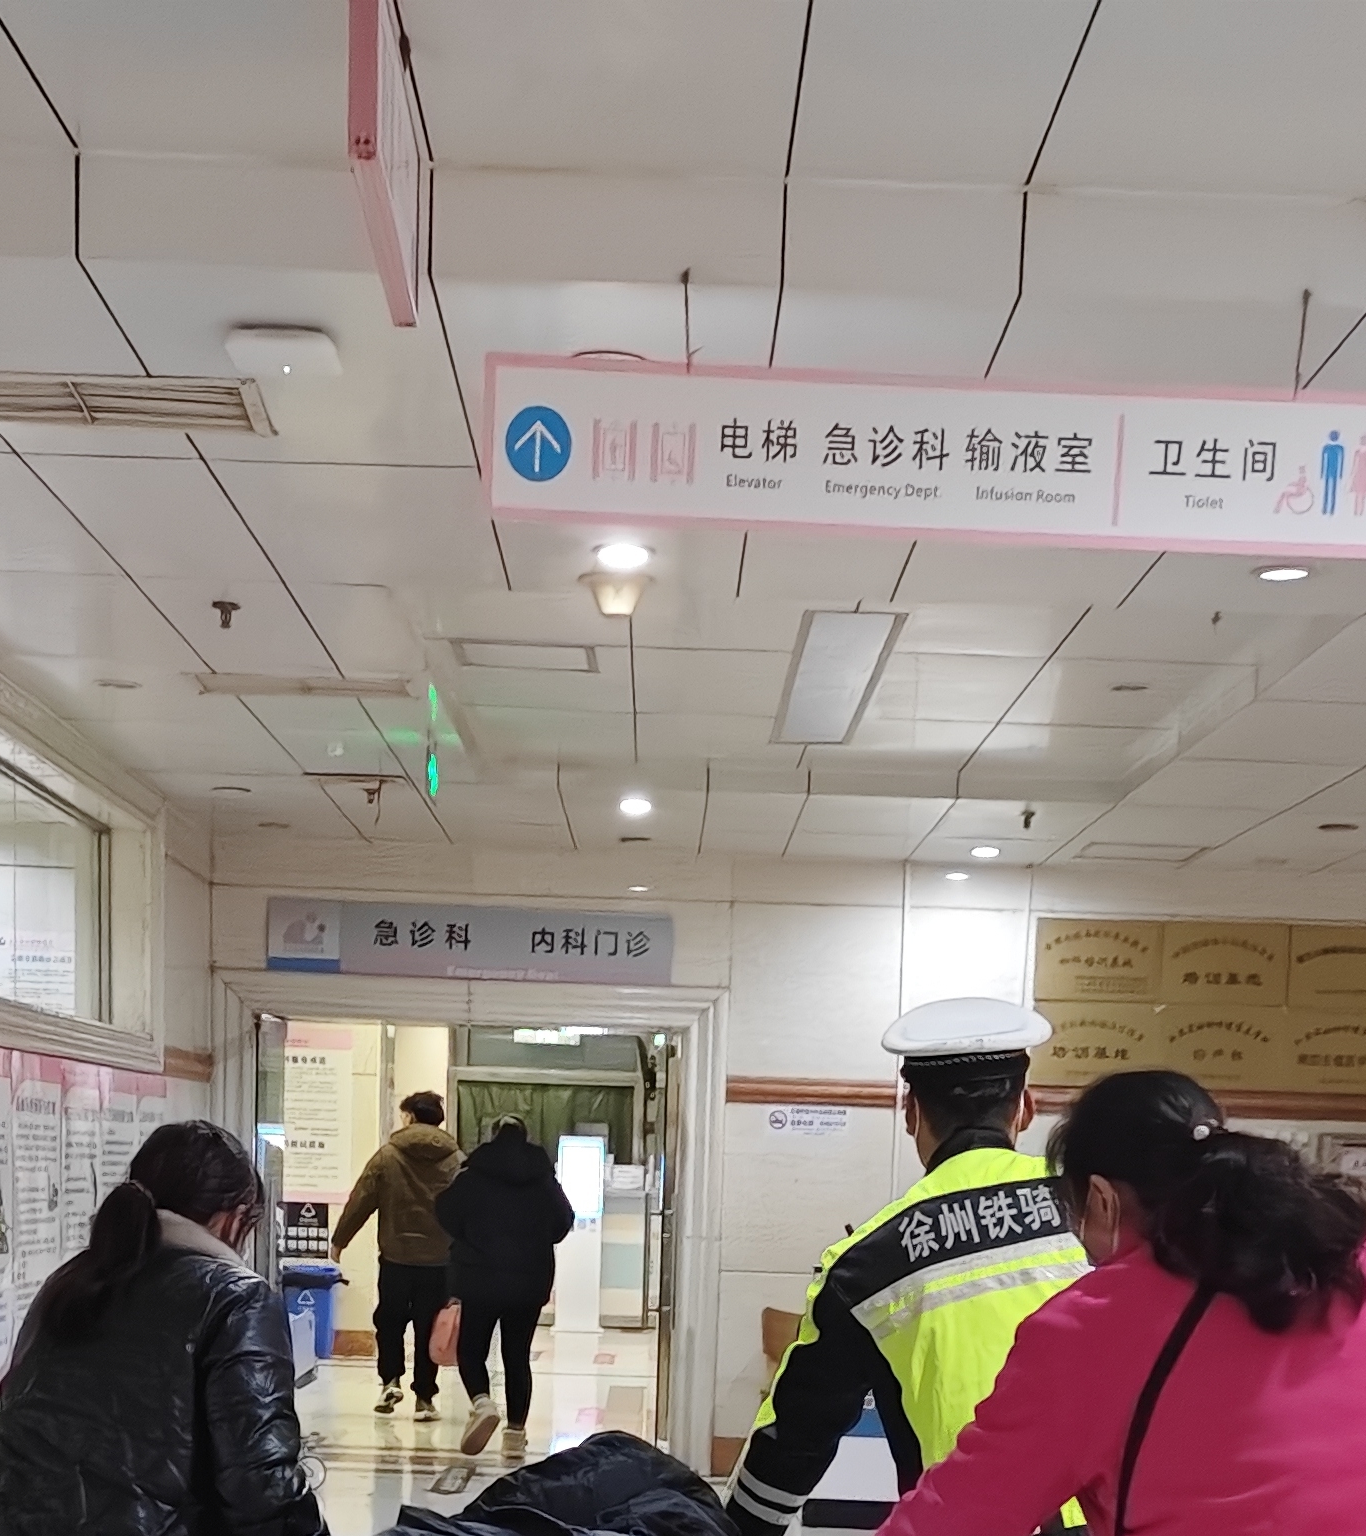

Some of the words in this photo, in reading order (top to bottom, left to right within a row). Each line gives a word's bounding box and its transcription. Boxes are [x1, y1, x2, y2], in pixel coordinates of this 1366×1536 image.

[720, 418, 797, 463] 电梯
[822, 423, 950, 470] 急诊科
[965, 428, 1092, 473] 输液室
[1149, 438, 1276, 481] 卫生间
[726, 474, 783, 489] Elevator
[825, 480, 901, 499] Emergency
[976, 486, 1032, 502] Infusion
[1036, 489, 1075, 503] Room
[373, 919, 471, 951] 急诊科
[531, 927, 650, 958] 内科门诊
[898, 1184, 1062, 1263] 徐州铁骑
